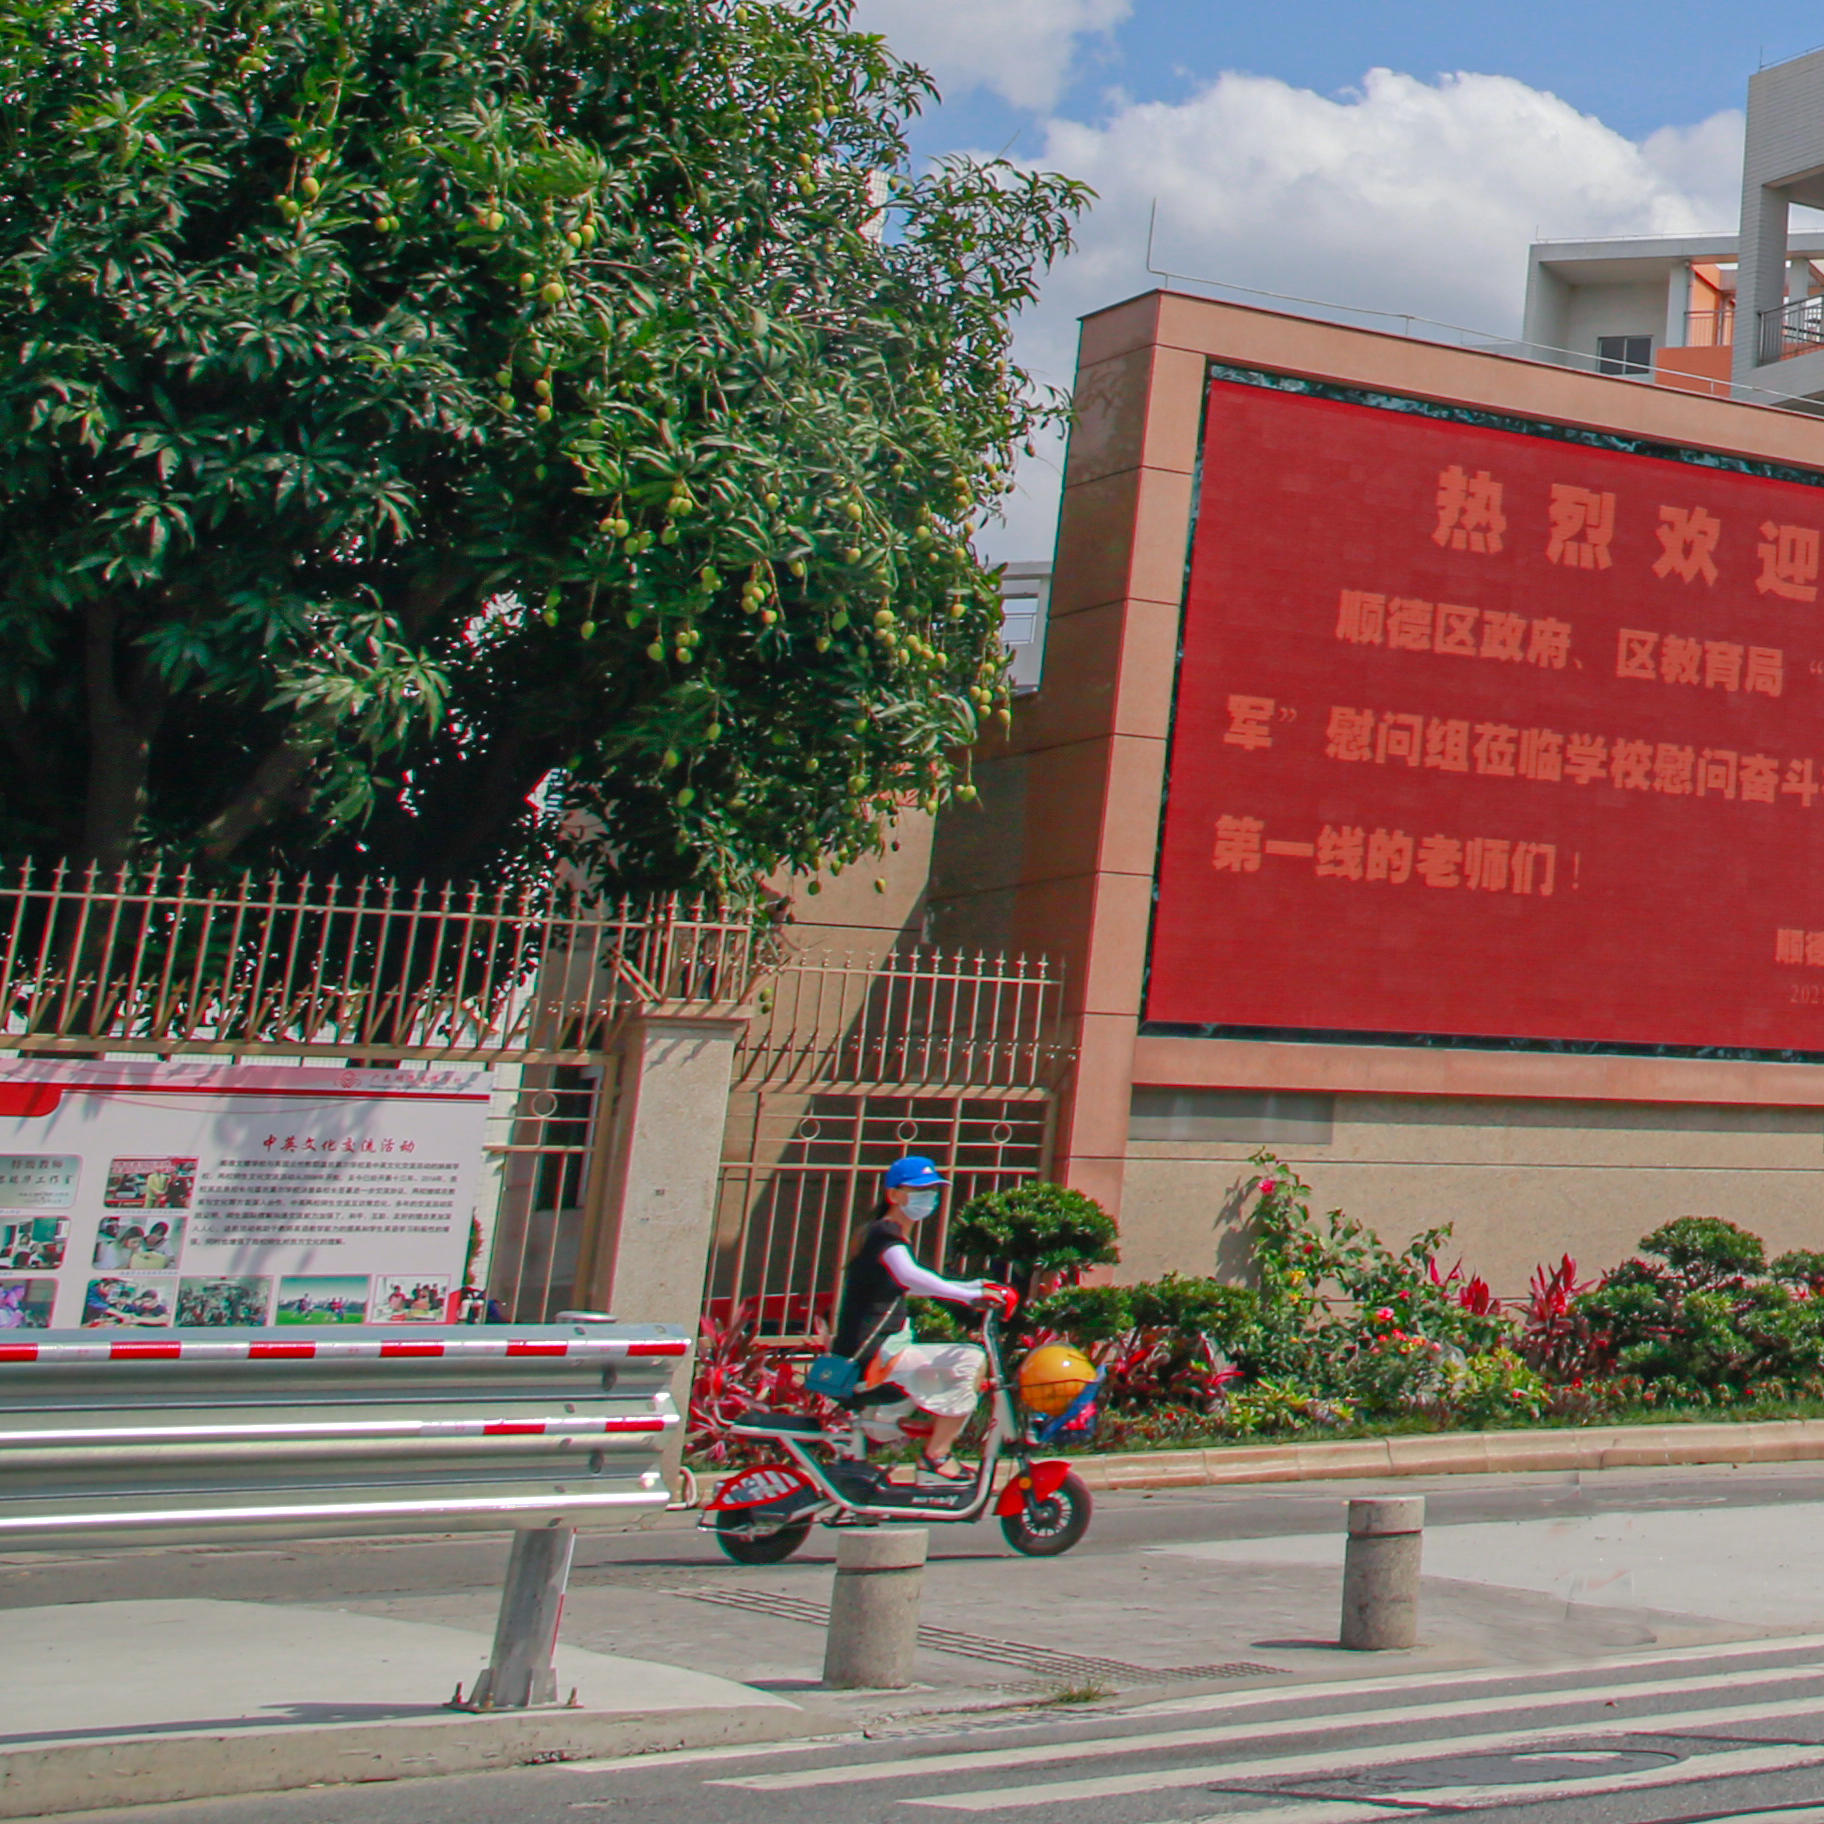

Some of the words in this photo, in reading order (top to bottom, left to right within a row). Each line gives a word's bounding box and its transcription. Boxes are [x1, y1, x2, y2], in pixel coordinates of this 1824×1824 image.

[1433, 464, 1822, 601] 热烈欢迎
[263, 1134, 416, 1153] 中英文化交流活动
